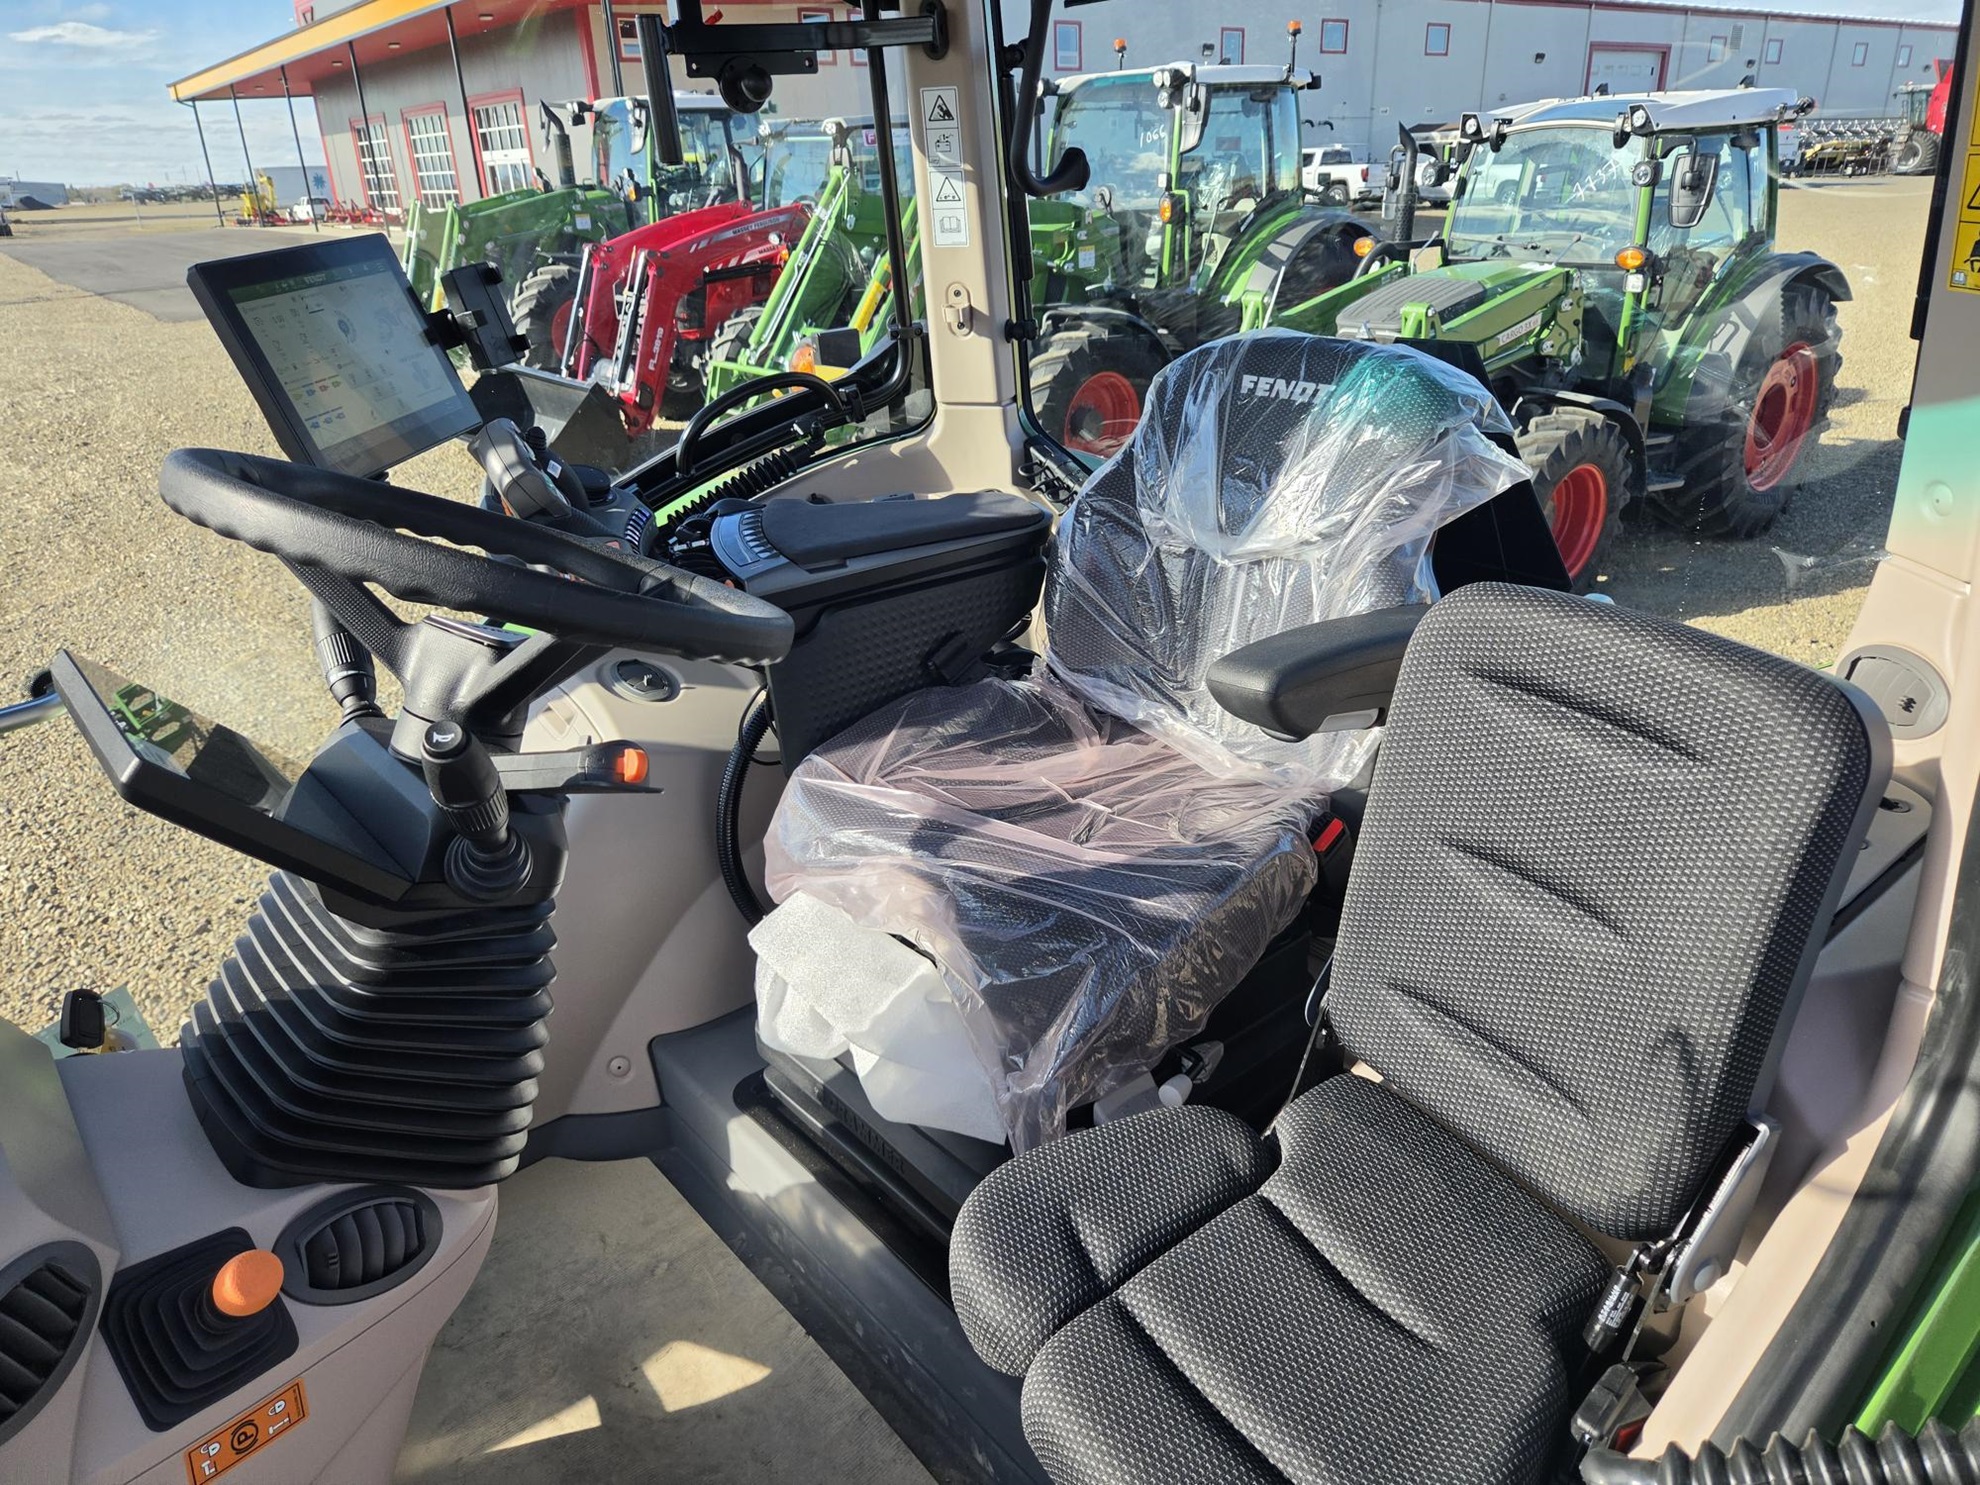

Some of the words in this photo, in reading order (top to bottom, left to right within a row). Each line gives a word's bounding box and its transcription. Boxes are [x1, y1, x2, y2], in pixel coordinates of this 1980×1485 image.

[1140, 124, 1165, 148] 1066
[732, 224, 753, 235] MASSEY
[1240, 374, 1336, 404] FENDT
